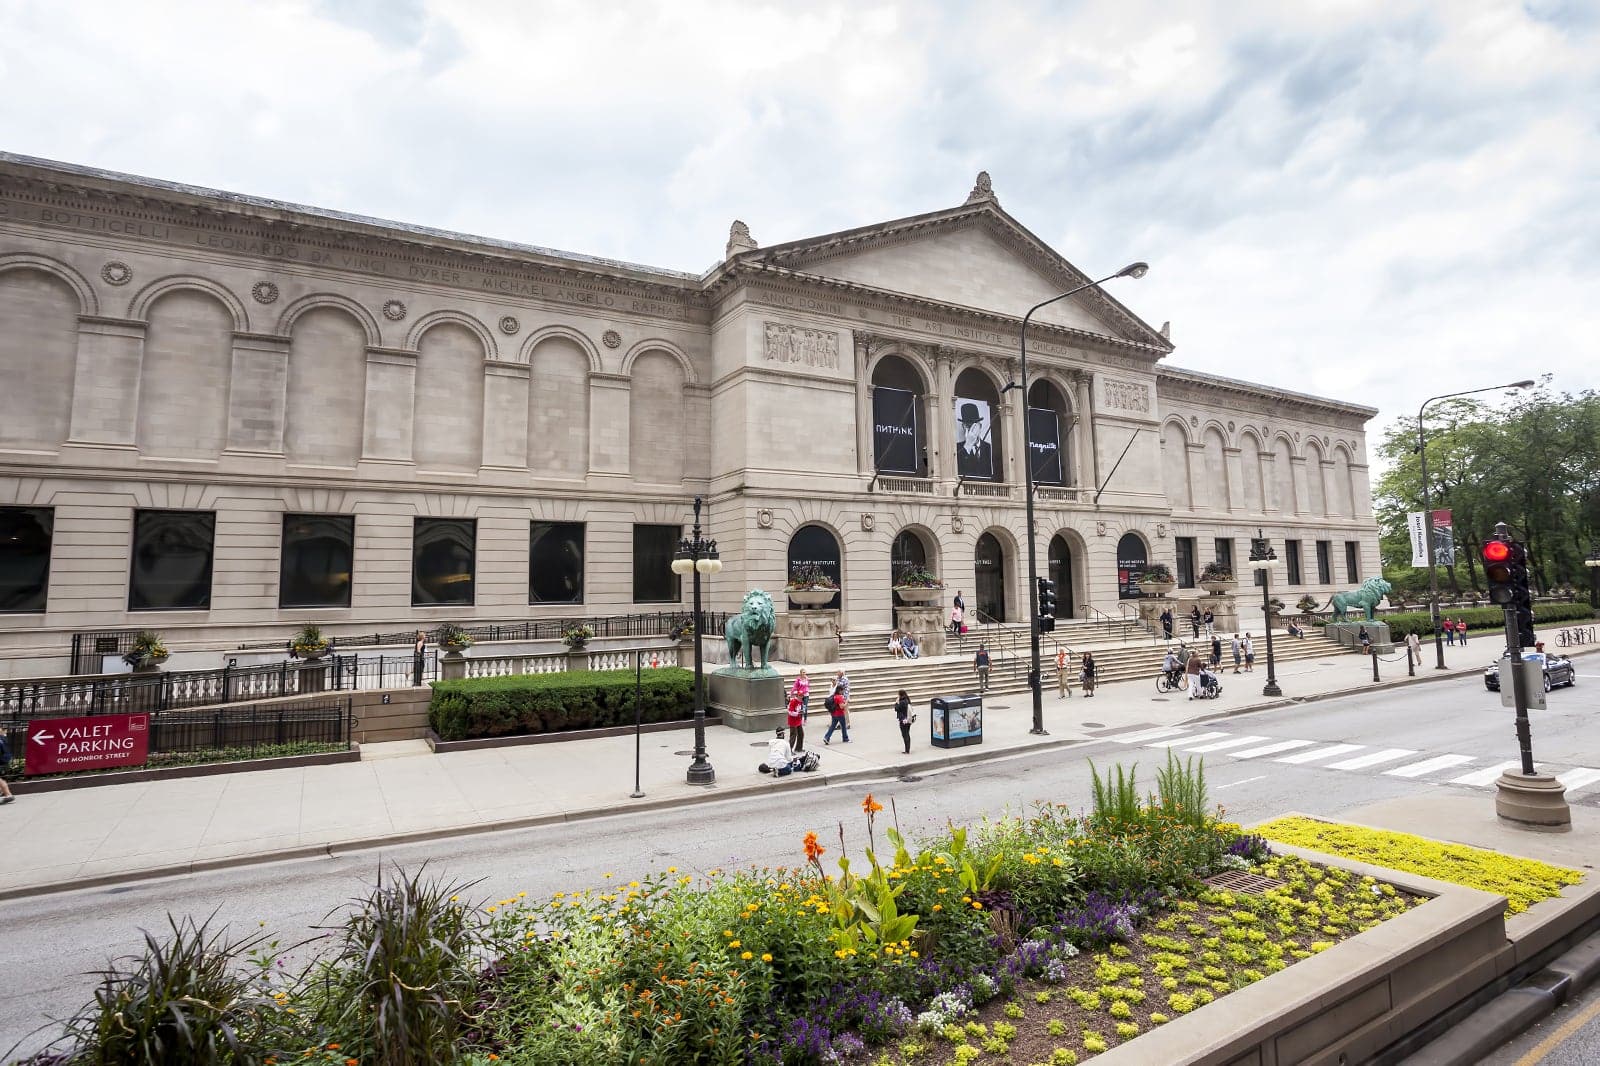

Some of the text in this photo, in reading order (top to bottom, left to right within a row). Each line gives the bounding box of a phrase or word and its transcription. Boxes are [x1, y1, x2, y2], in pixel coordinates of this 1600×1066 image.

[41, 208, 170, 239] BOTTICELLI
[196, 234, 386, 273] LEONARDO DA VINCI
[482, 278, 615, 307] MICHAEL ANGELO
[762, 291, 841, 314] ANNO DOMINI
[632, 300, 689, 320] RAPHAEL
[892, 315, 912, 327] THE
[925, 320, 942, 333] ART
[59, 724, 113, 740] VALET
[58, 737, 134, 754] PARKING
[71, 754, 103, 763] MONROE
[104, 752, 130, 760] STREET
